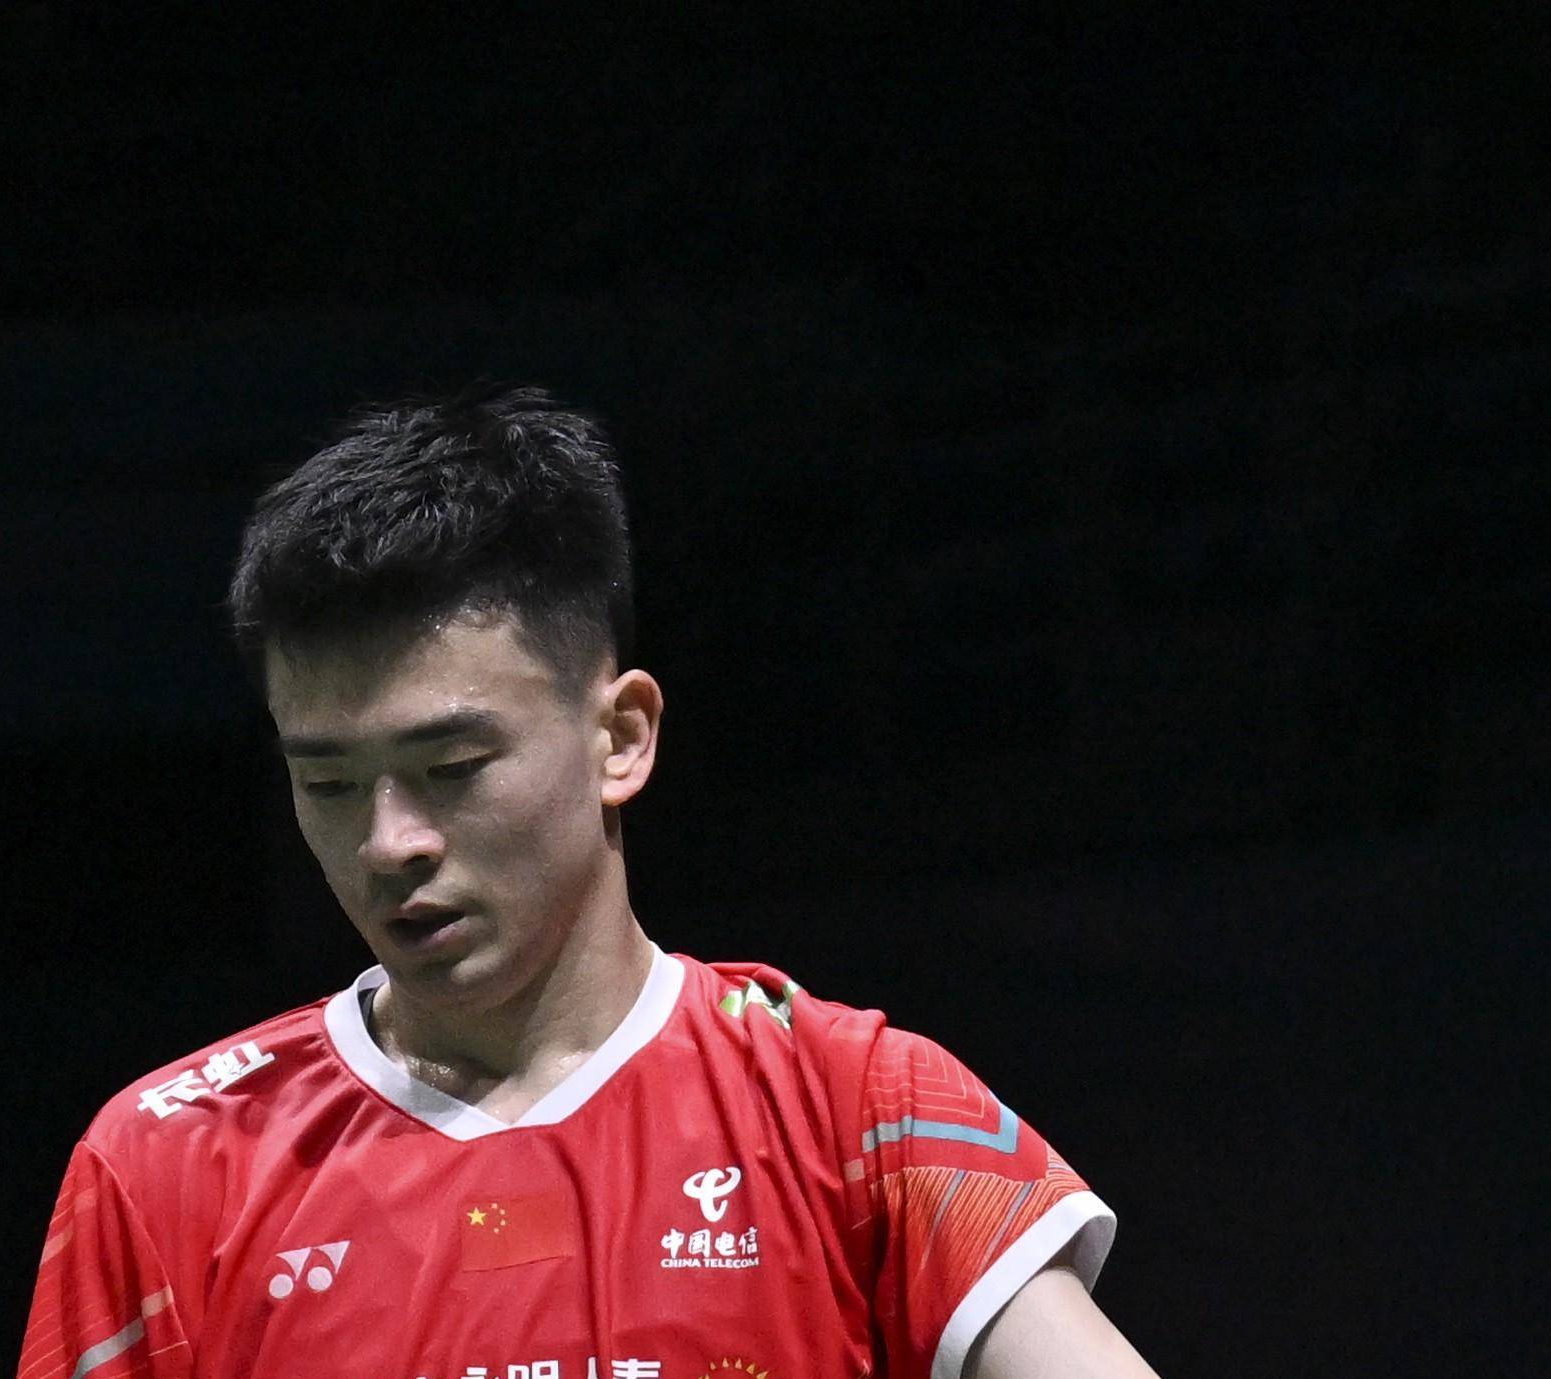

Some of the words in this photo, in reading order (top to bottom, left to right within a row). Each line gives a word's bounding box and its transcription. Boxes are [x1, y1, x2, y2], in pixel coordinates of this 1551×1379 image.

[660, 1226, 759, 1259] 中国电信
[660, 1258, 701, 1269] CHINA
[703, 1257, 760, 1269] TELECOM
